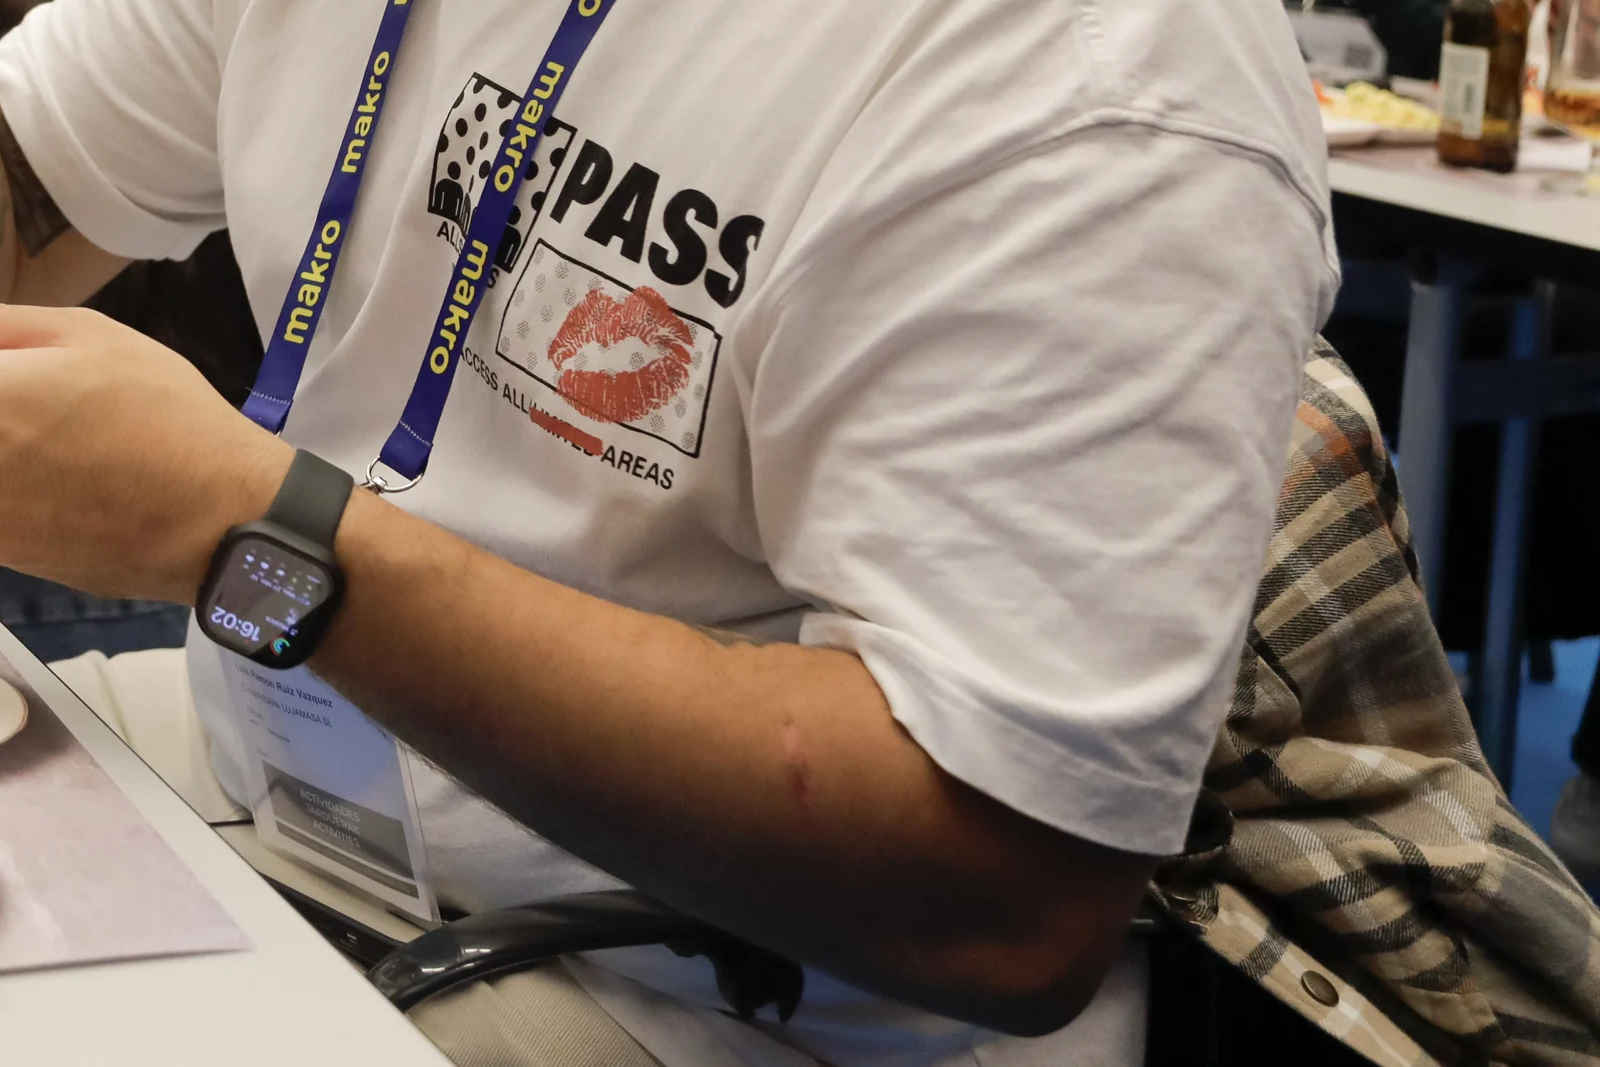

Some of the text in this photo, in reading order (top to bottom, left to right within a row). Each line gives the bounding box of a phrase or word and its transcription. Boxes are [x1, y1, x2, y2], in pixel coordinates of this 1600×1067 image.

[494, 61, 564, 193] makro
[284, 220, 341, 344] makro
[341, 51, 390, 173] makro
[549, 138, 766, 310] PASS
[429, 239, 489, 375] makro
[601, 445, 675, 491] AREAS
[211, 605, 260, 642] 16:02
[276, 681, 296, 697] Ruiz
[296, 688, 334, 708] Vazquez
[300, 788, 360, 822] ACTIVIDADES
[313, 819, 361, 848] ACTIVITIES
